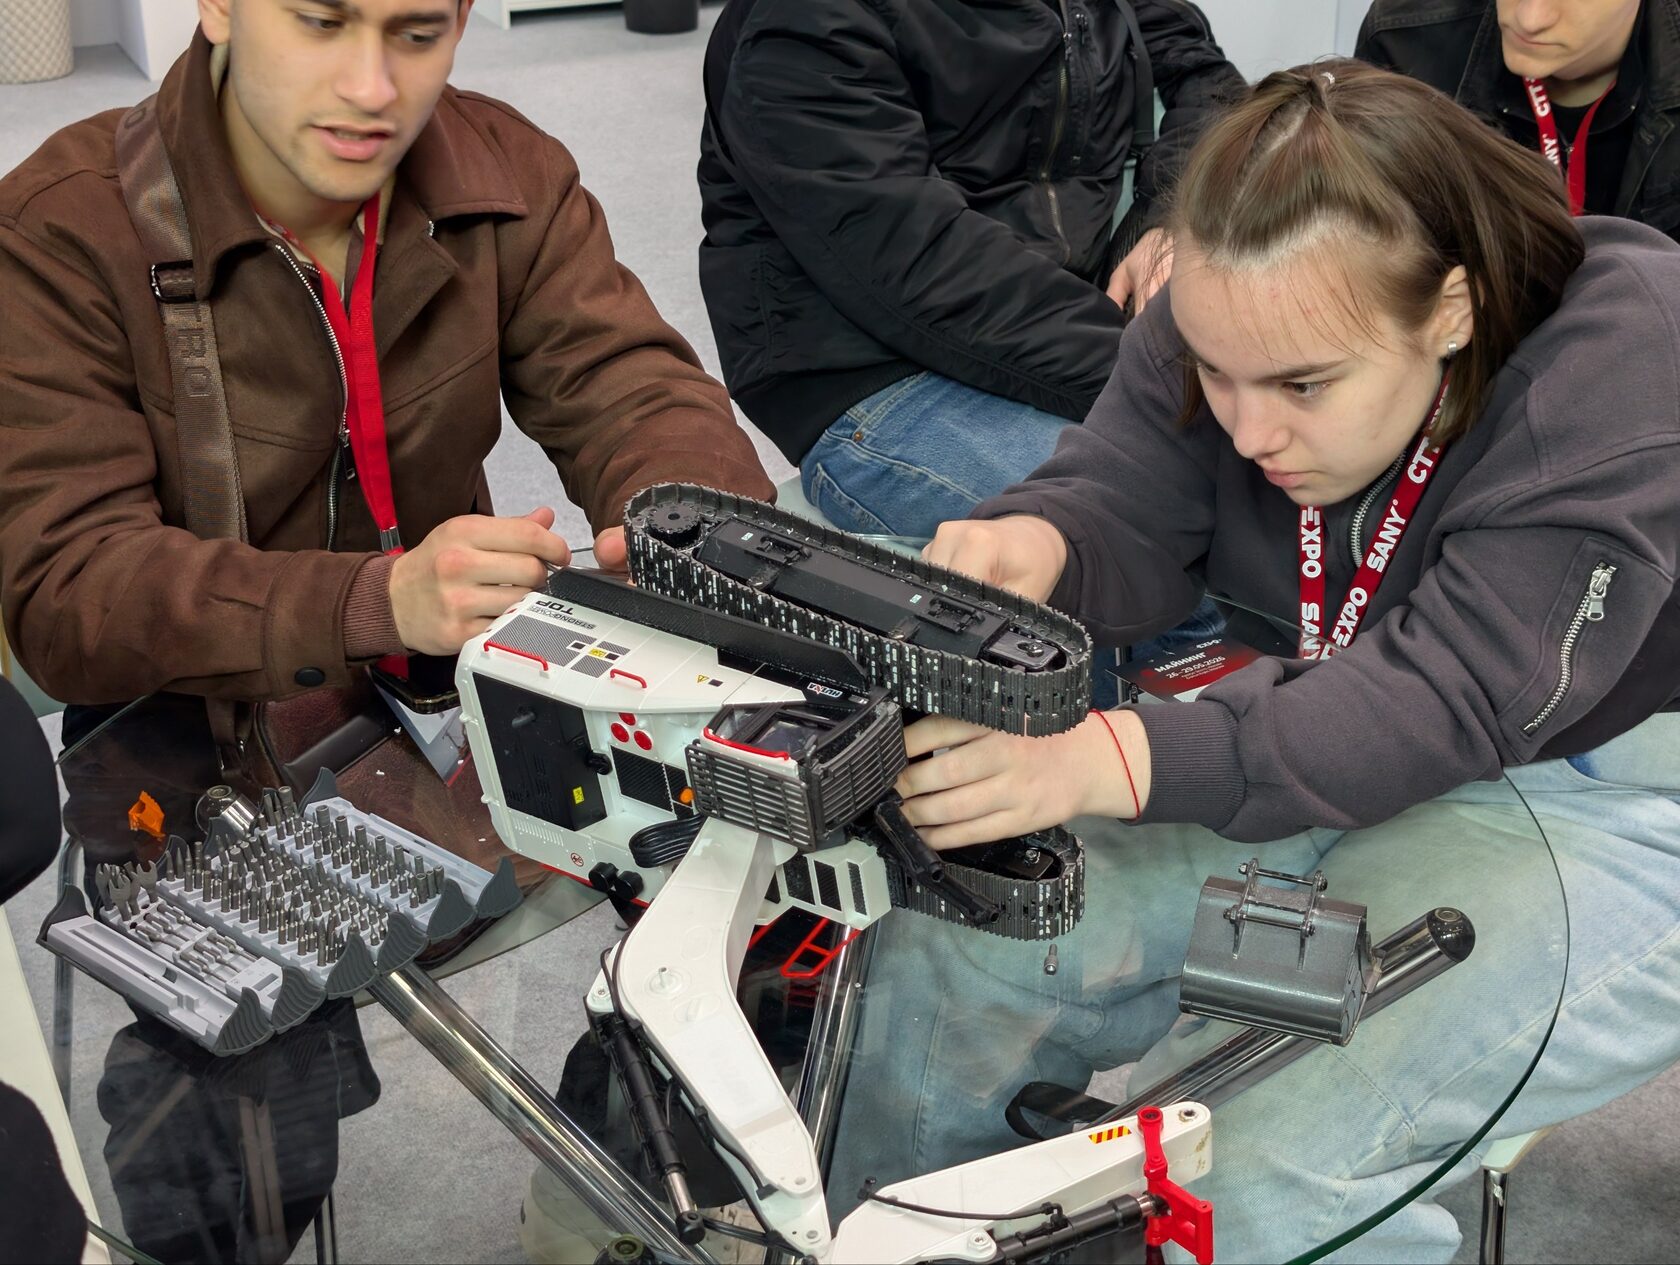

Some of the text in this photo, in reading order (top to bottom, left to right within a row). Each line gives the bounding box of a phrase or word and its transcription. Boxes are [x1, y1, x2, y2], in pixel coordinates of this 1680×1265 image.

[1300, 506, 1322, 579] EXPO
[1331, 586, 1368, 648] EXPO
[1366, 505, 1407, 573] SANY
[535, 600, 574, 616] TOP
